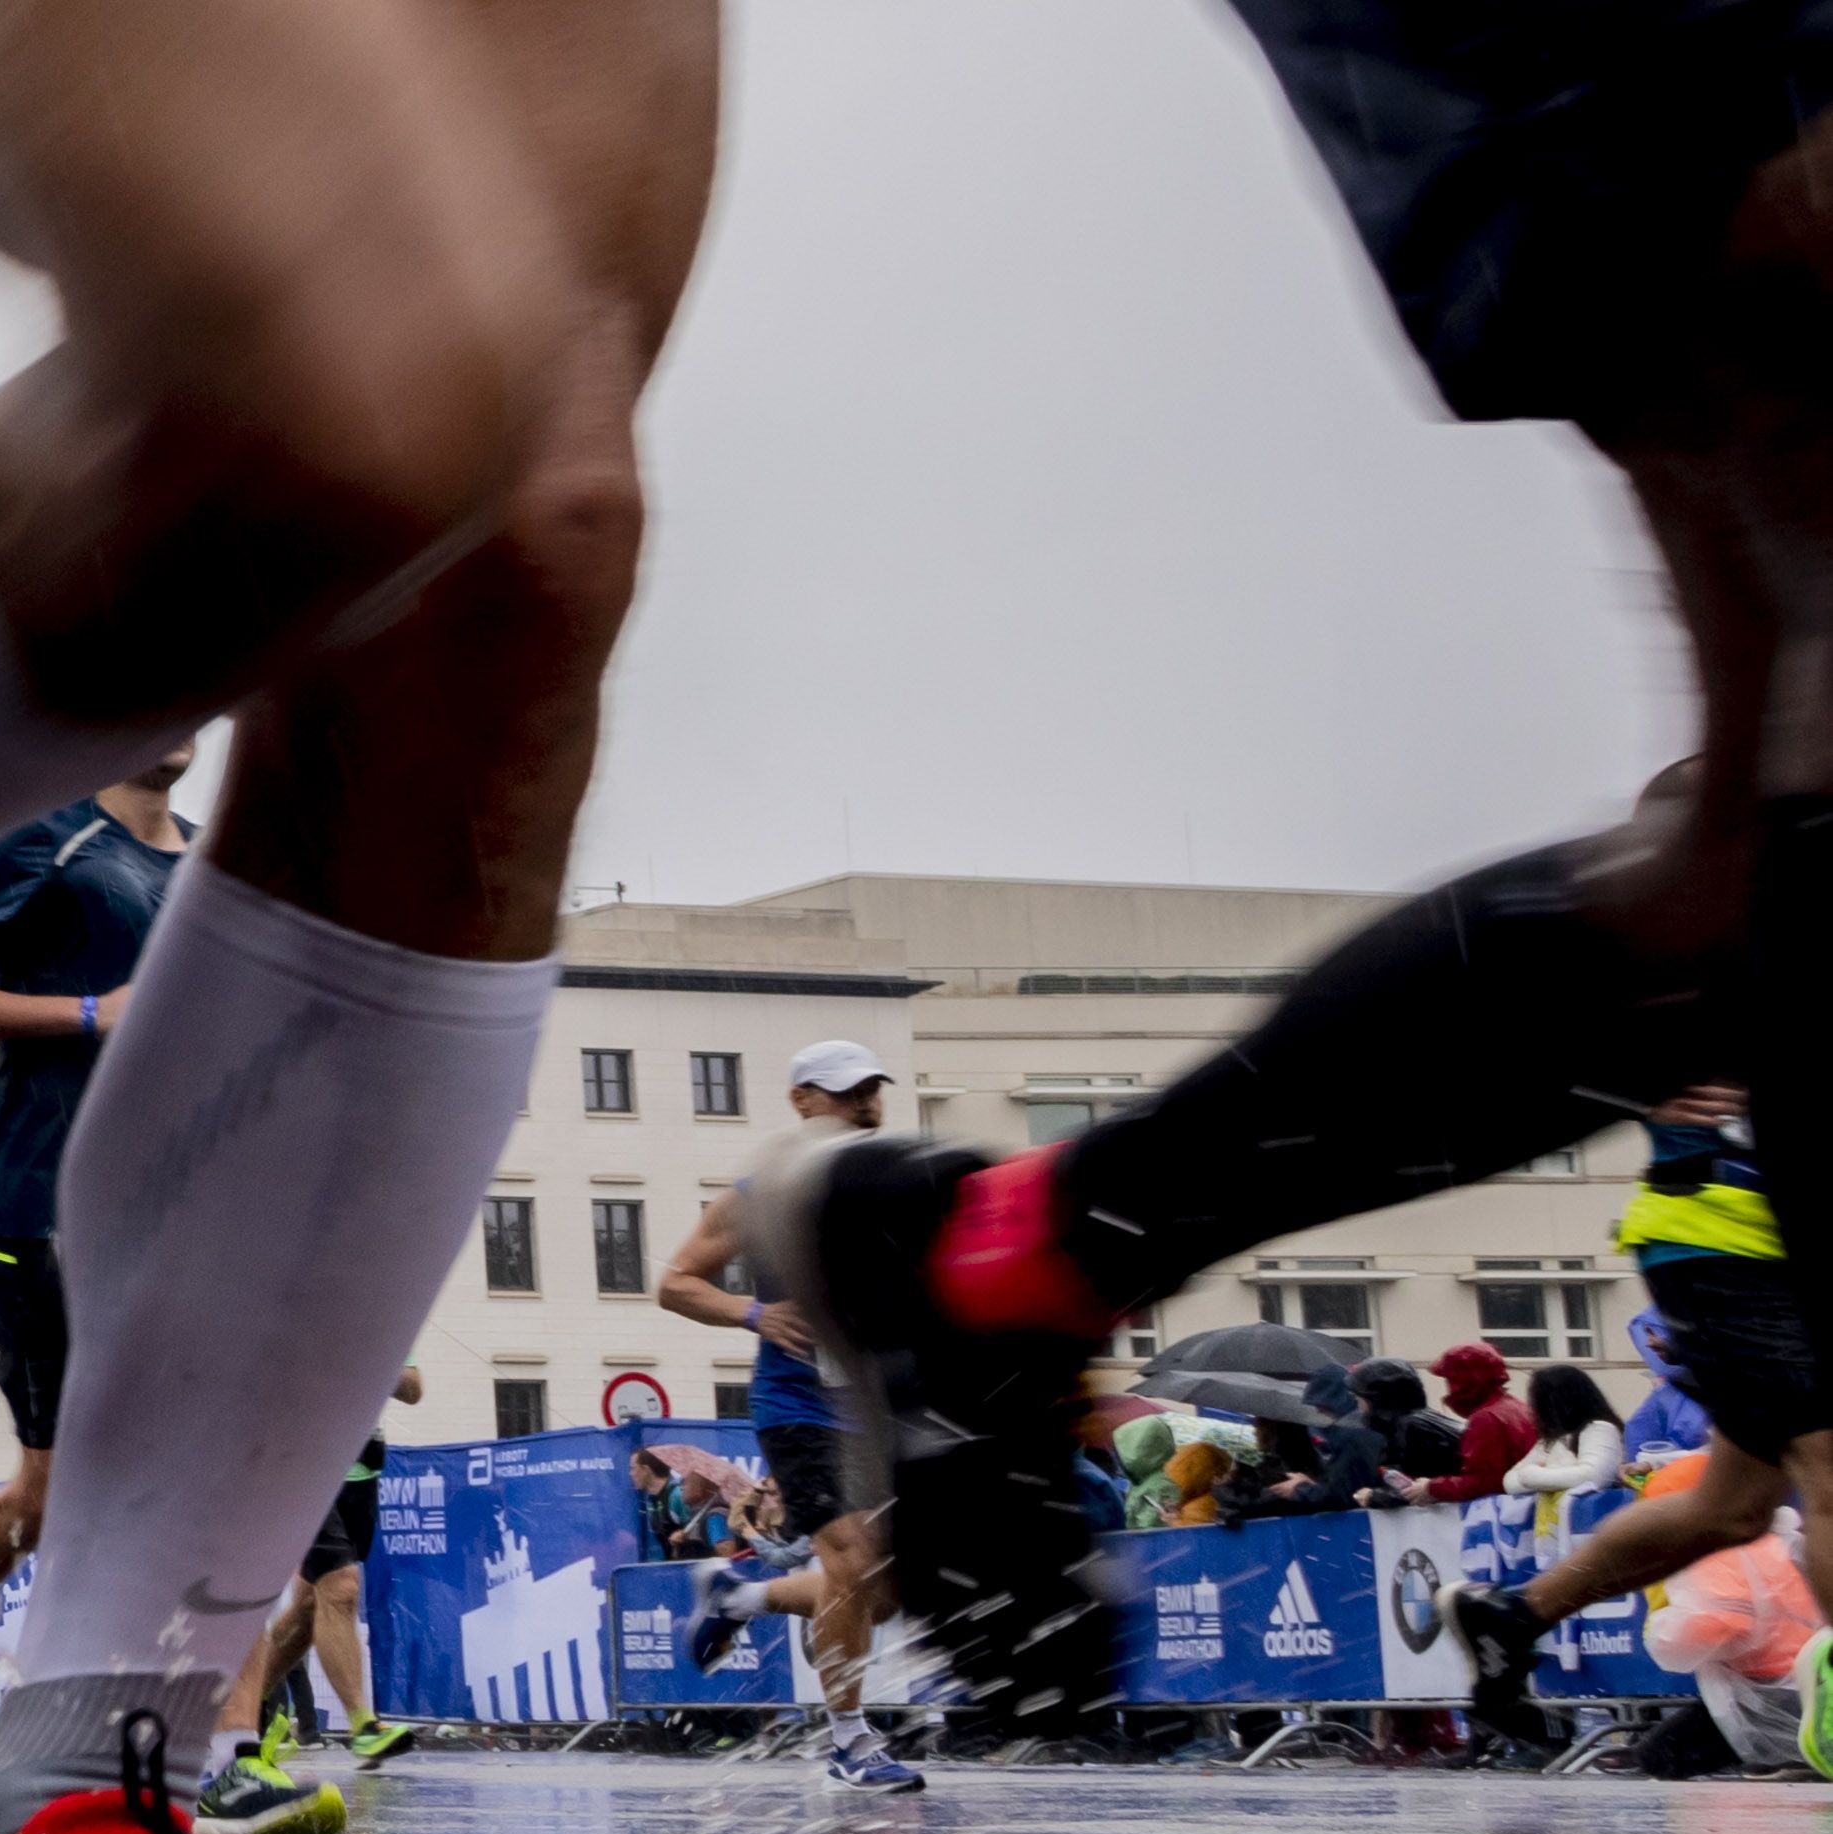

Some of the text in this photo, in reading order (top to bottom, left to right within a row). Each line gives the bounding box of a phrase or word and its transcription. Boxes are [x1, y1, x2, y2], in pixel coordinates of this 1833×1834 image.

[494, 1465, 525, 1477] WORLD
[527, 1460, 578, 1475] MARATHON
[1263, 1622, 1333, 1658] adidas
[1581, 1630, 1632, 1654] Abbott
